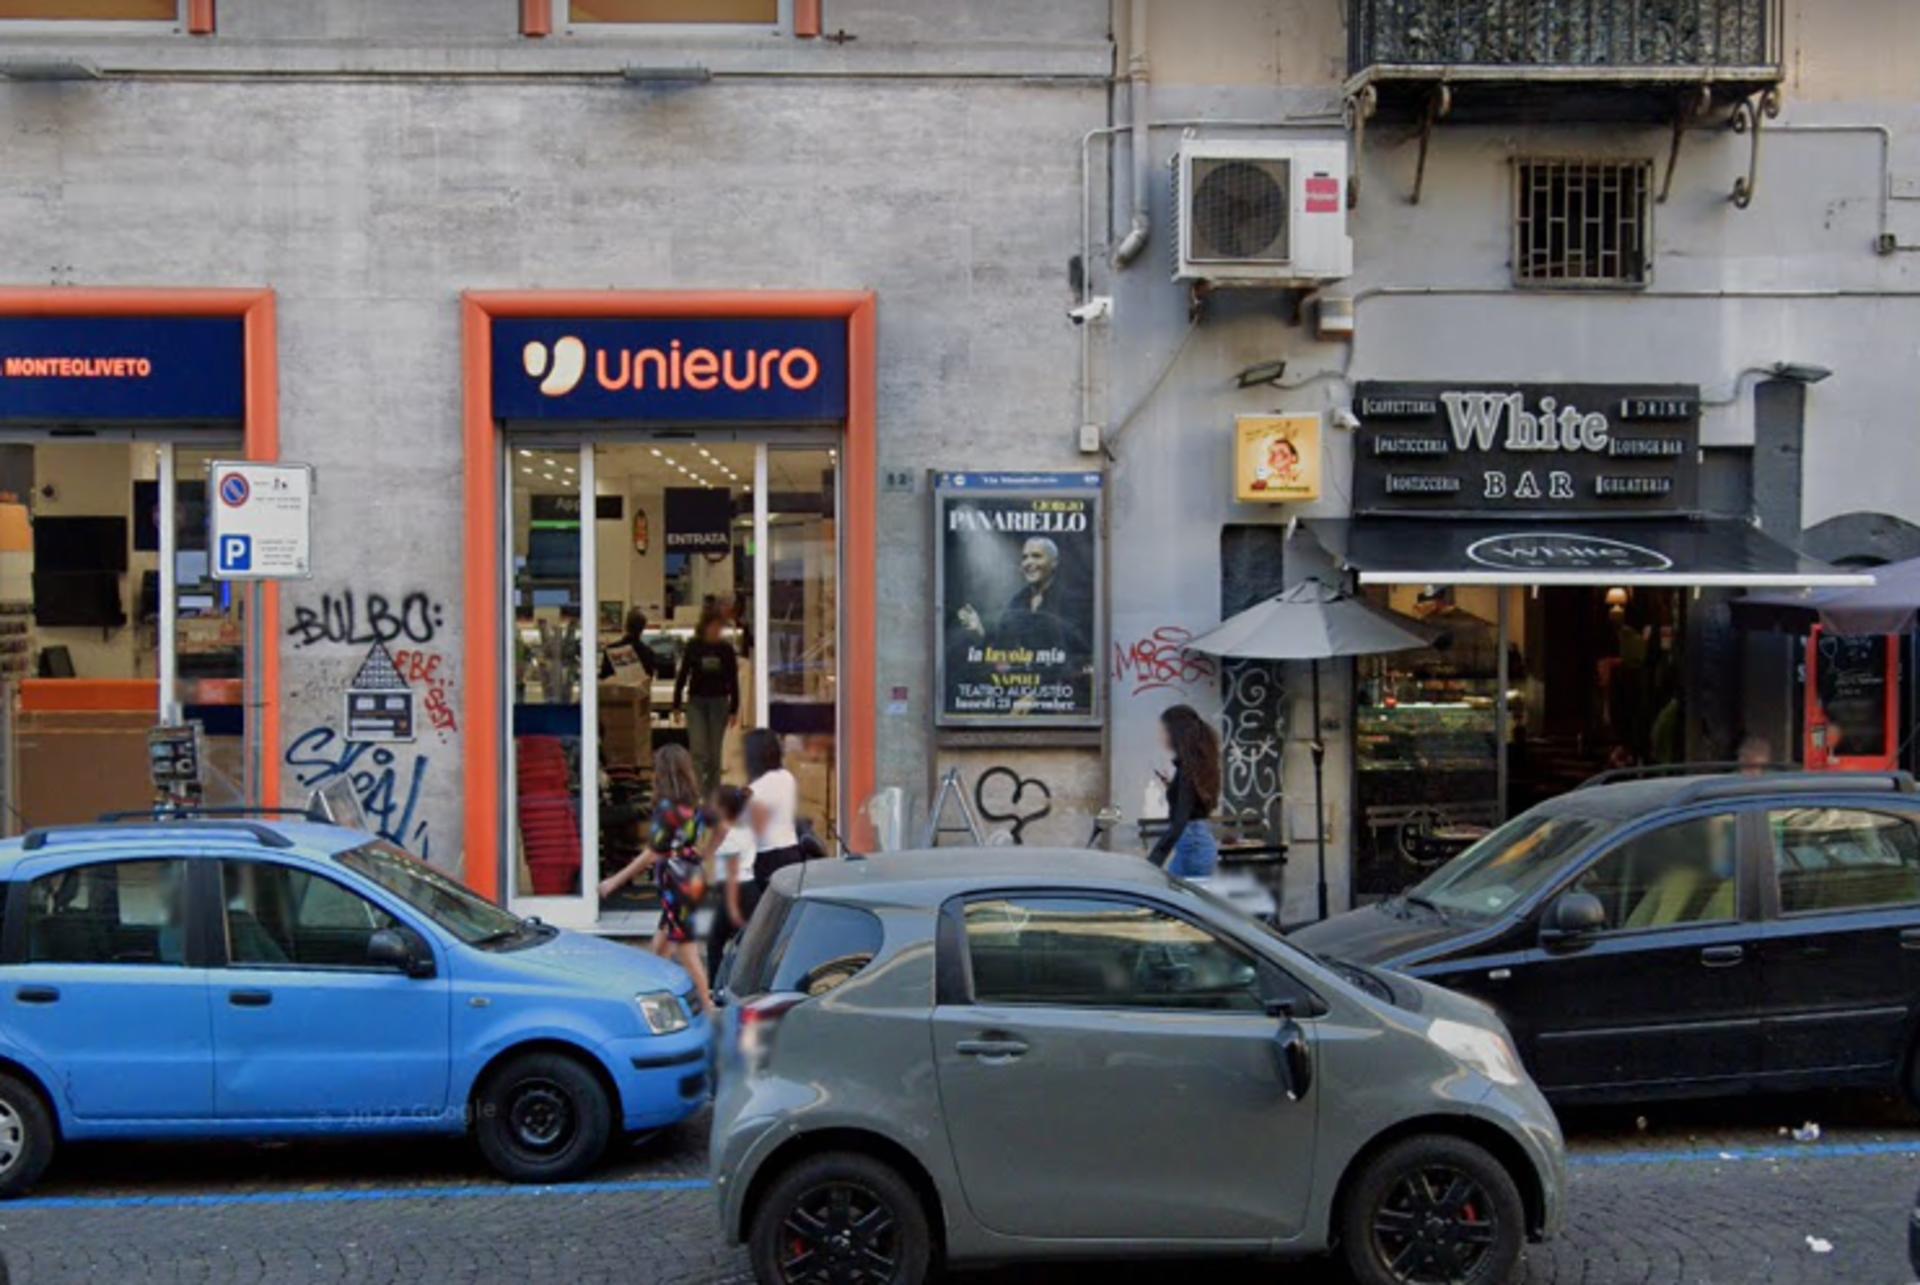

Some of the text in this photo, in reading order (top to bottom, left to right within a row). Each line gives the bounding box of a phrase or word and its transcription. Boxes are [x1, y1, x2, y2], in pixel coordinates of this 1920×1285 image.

[5, 357, 151, 376] MONTEOLIVETO
[596, 339, 819, 390] unieuro
[1440, 391, 1609, 452] White
[1483, 471, 1574, 498] BAR
[949, 510, 1087, 532] PANARIELLO
[668, 533, 729, 545] ENTRATA
